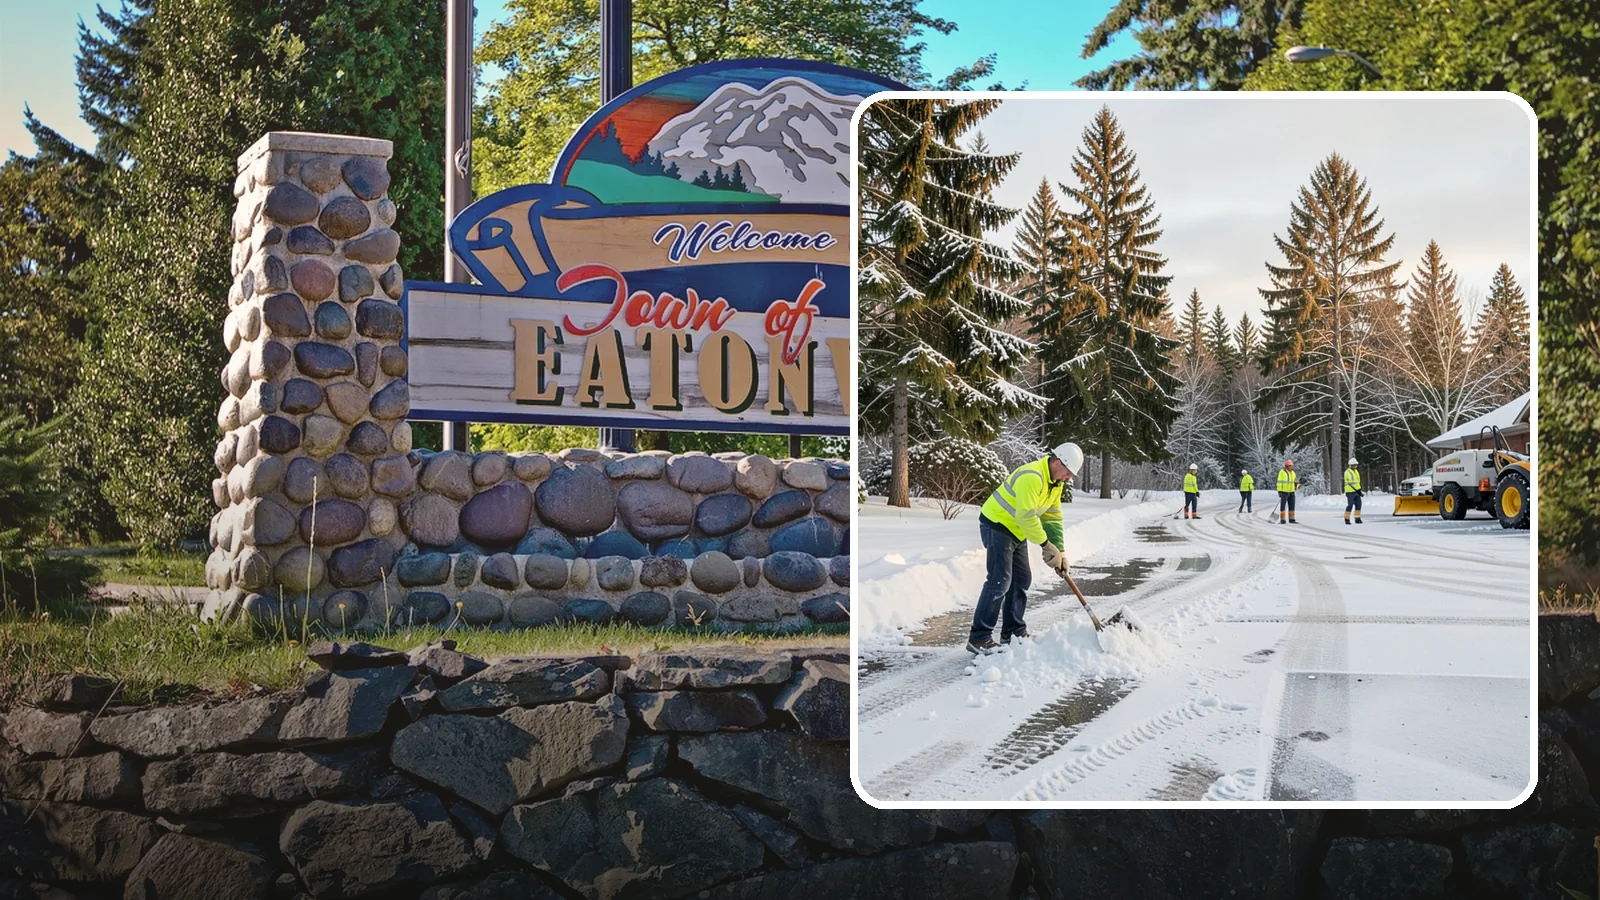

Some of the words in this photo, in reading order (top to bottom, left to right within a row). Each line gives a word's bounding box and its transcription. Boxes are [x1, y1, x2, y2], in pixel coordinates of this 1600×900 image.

[653, 220, 837, 263] Welcome
[556, 263, 737, 336] Town
[765, 278, 826, 365] of
